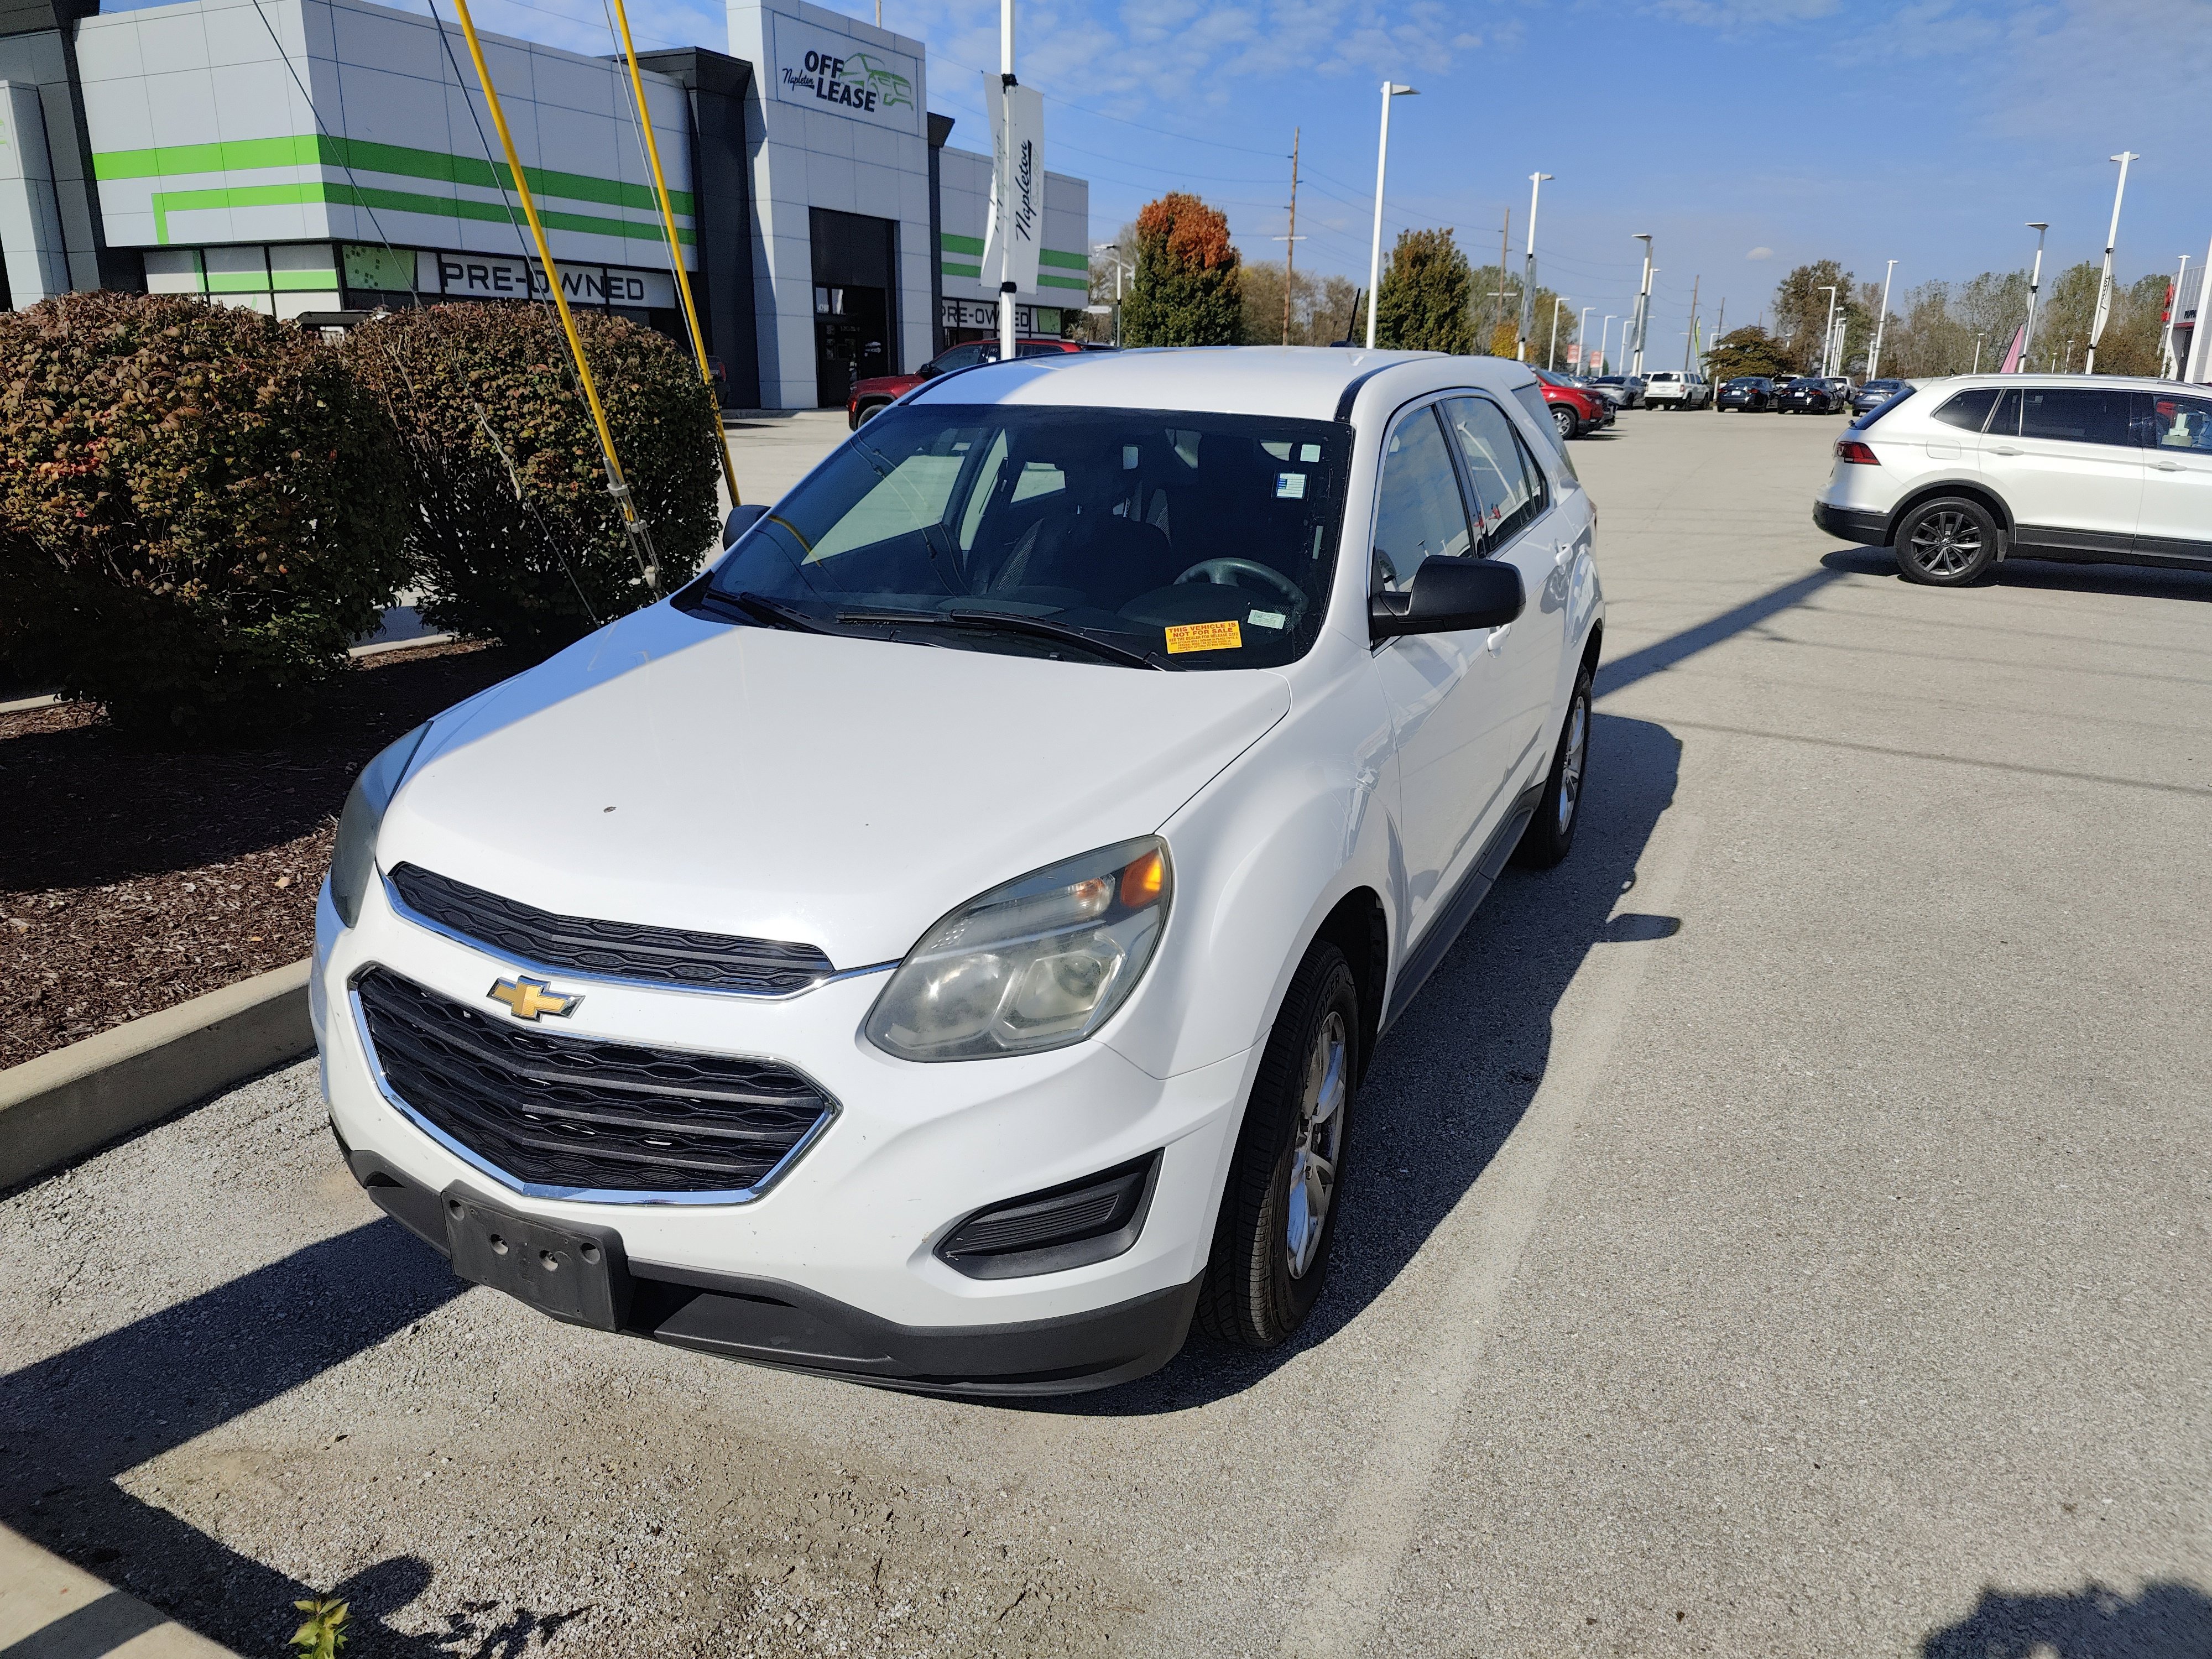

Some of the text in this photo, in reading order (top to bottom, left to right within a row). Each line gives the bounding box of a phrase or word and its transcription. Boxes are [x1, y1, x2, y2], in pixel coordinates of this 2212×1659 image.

[782, 69, 815, 91] Napleton
[805, 50, 844, 79] OFF
[816, 77, 877, 112] LEASE
[1015, 140, 1037, 241] Napleton
[442, 262, 644, 300] PRE-OWNED
[942, 306, 1029, 327] RE-OWD
[1308, 973, 1340, 1058] COOPER
